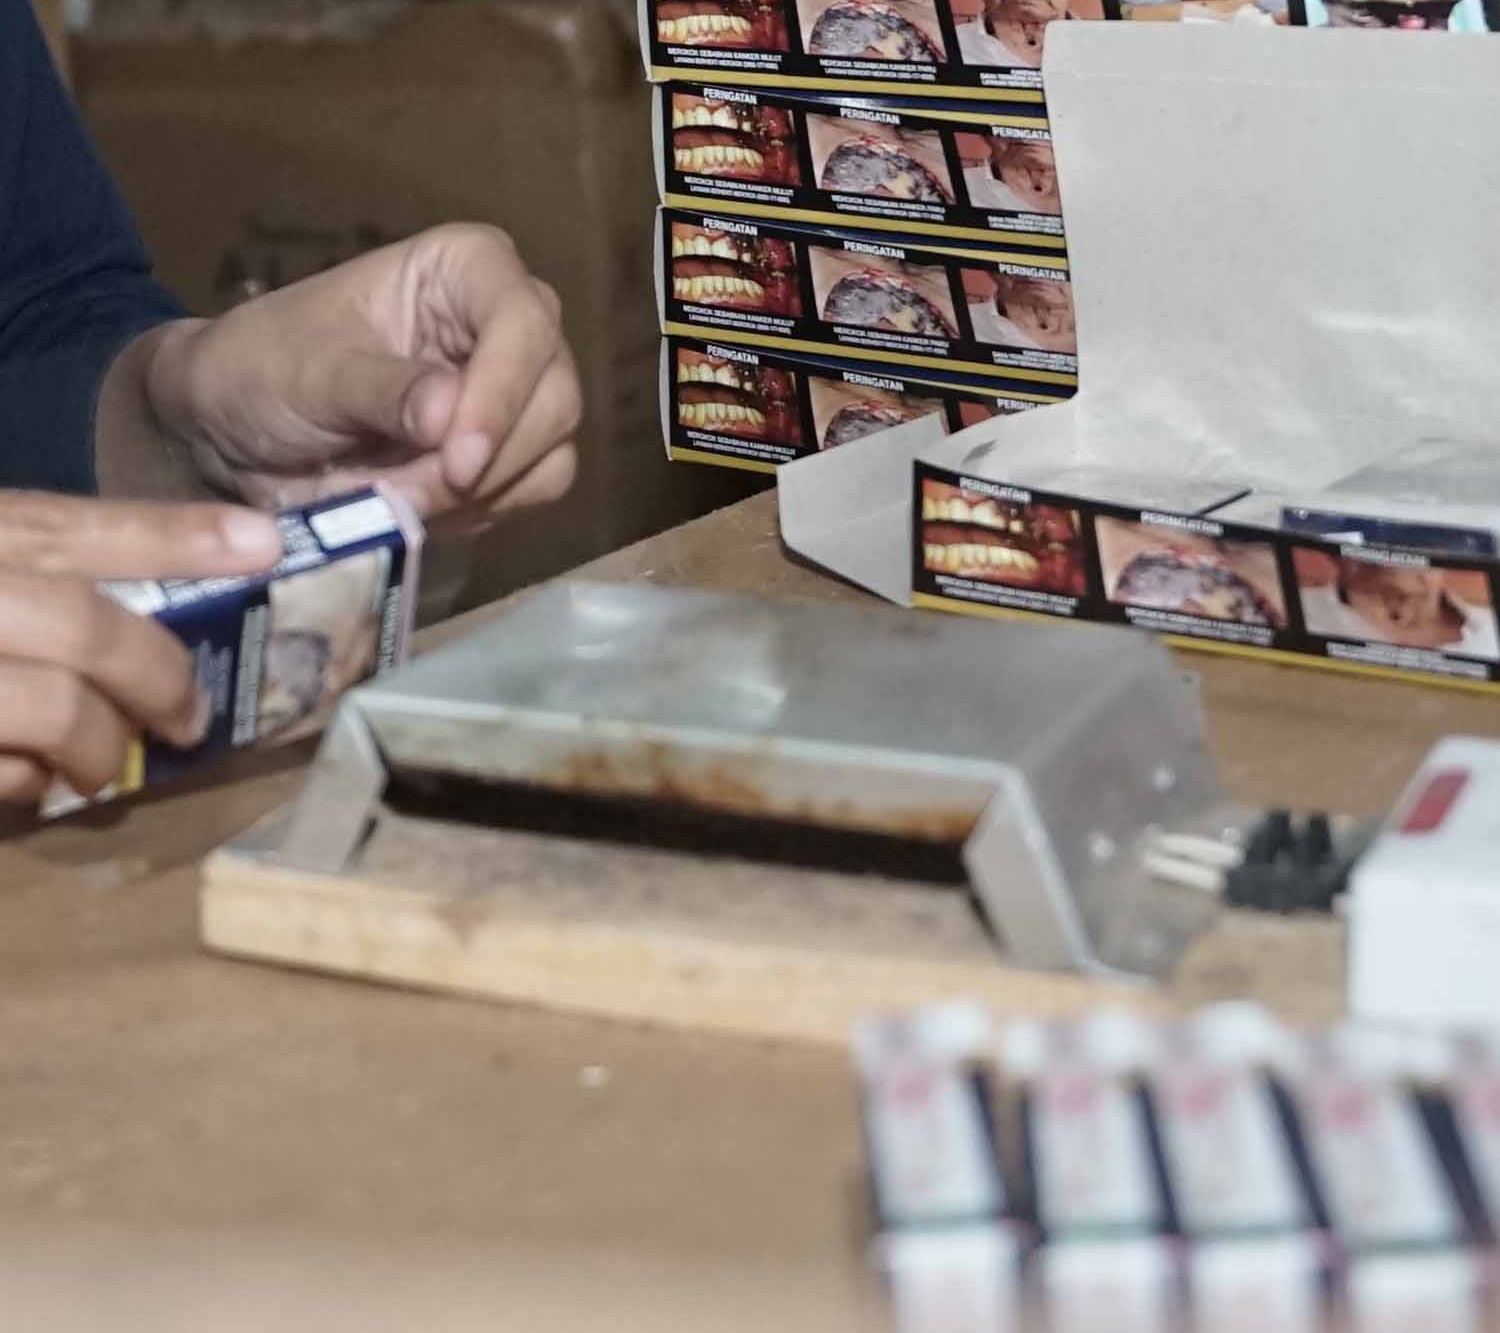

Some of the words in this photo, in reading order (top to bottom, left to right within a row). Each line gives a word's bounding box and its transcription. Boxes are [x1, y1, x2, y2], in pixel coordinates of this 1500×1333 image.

[704, 88, 757, 105] PERINGATAN
[840, 107, 899, 125] PERINGATAN
[992, 126, 1050, 141] PERINGATA
[703, 218, 758, 236] PERINGATAN
[844, 241, 905, 259] PERINGATAN
[999, 263, 1065, 282] PERINGATAN
[707, 345, 759, 366] PERINGATAN
[843, 372, 904, 392] PERINGATAN
[960, 477, 1032, 503] PERINGATAN
[1141, 511, 1223, 534] PERINGATAN
